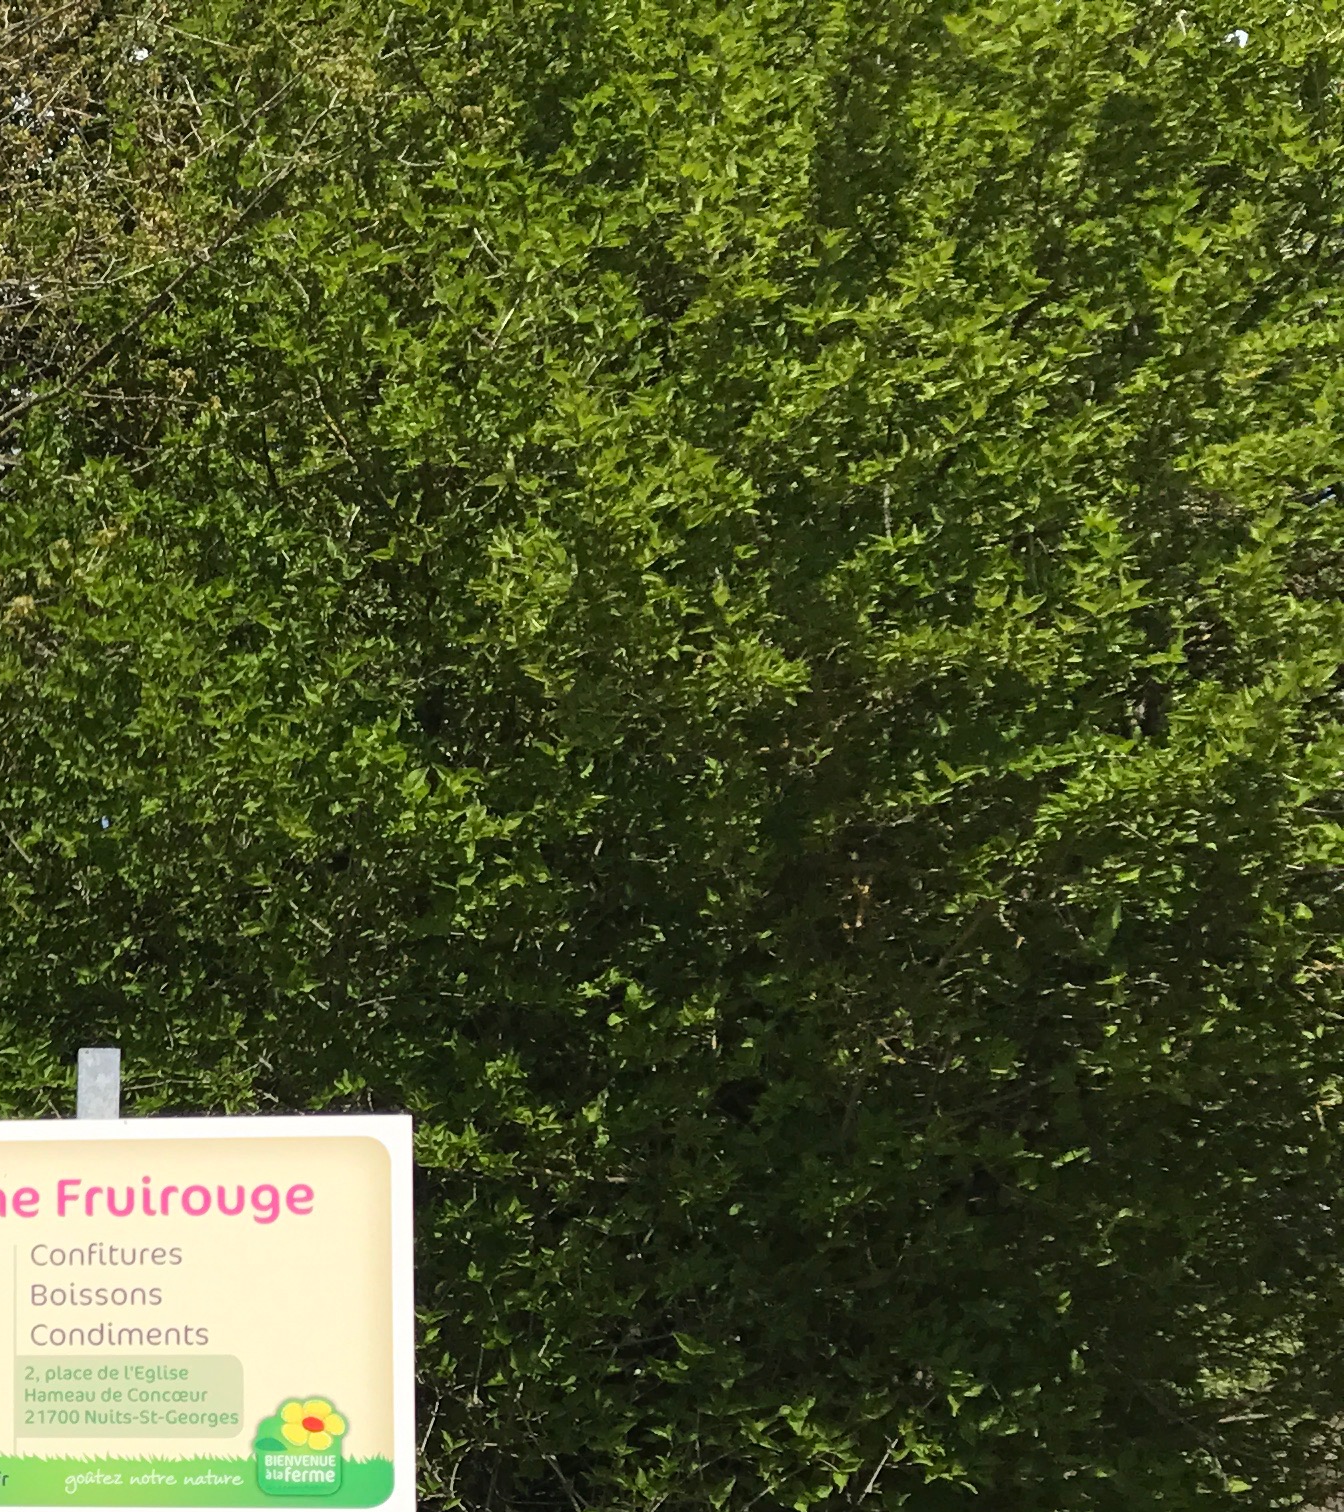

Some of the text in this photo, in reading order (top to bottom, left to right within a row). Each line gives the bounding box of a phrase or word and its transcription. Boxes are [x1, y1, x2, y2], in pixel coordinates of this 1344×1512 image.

[56, 1175, 315, 1225] Fruirouge
[30, 1242, 183, 1266] Confitures
[30, 1282, 163, 1306] Boissons
[30, 1322, 209, 1346] Condiments
[24, 1365, 189, 1384] 2, place de l'Eglise
[24, 1387, 208, 1402] Hameau de Concœur
[24, 1409, 240, 1428] 21700 Nuits-St-Georges
[264, 1454, 336, 1467] BIENVENUE
[64, 1468, 244, 1495] goûtez notre nature
[283, 1466, 335, 1483] ferme
